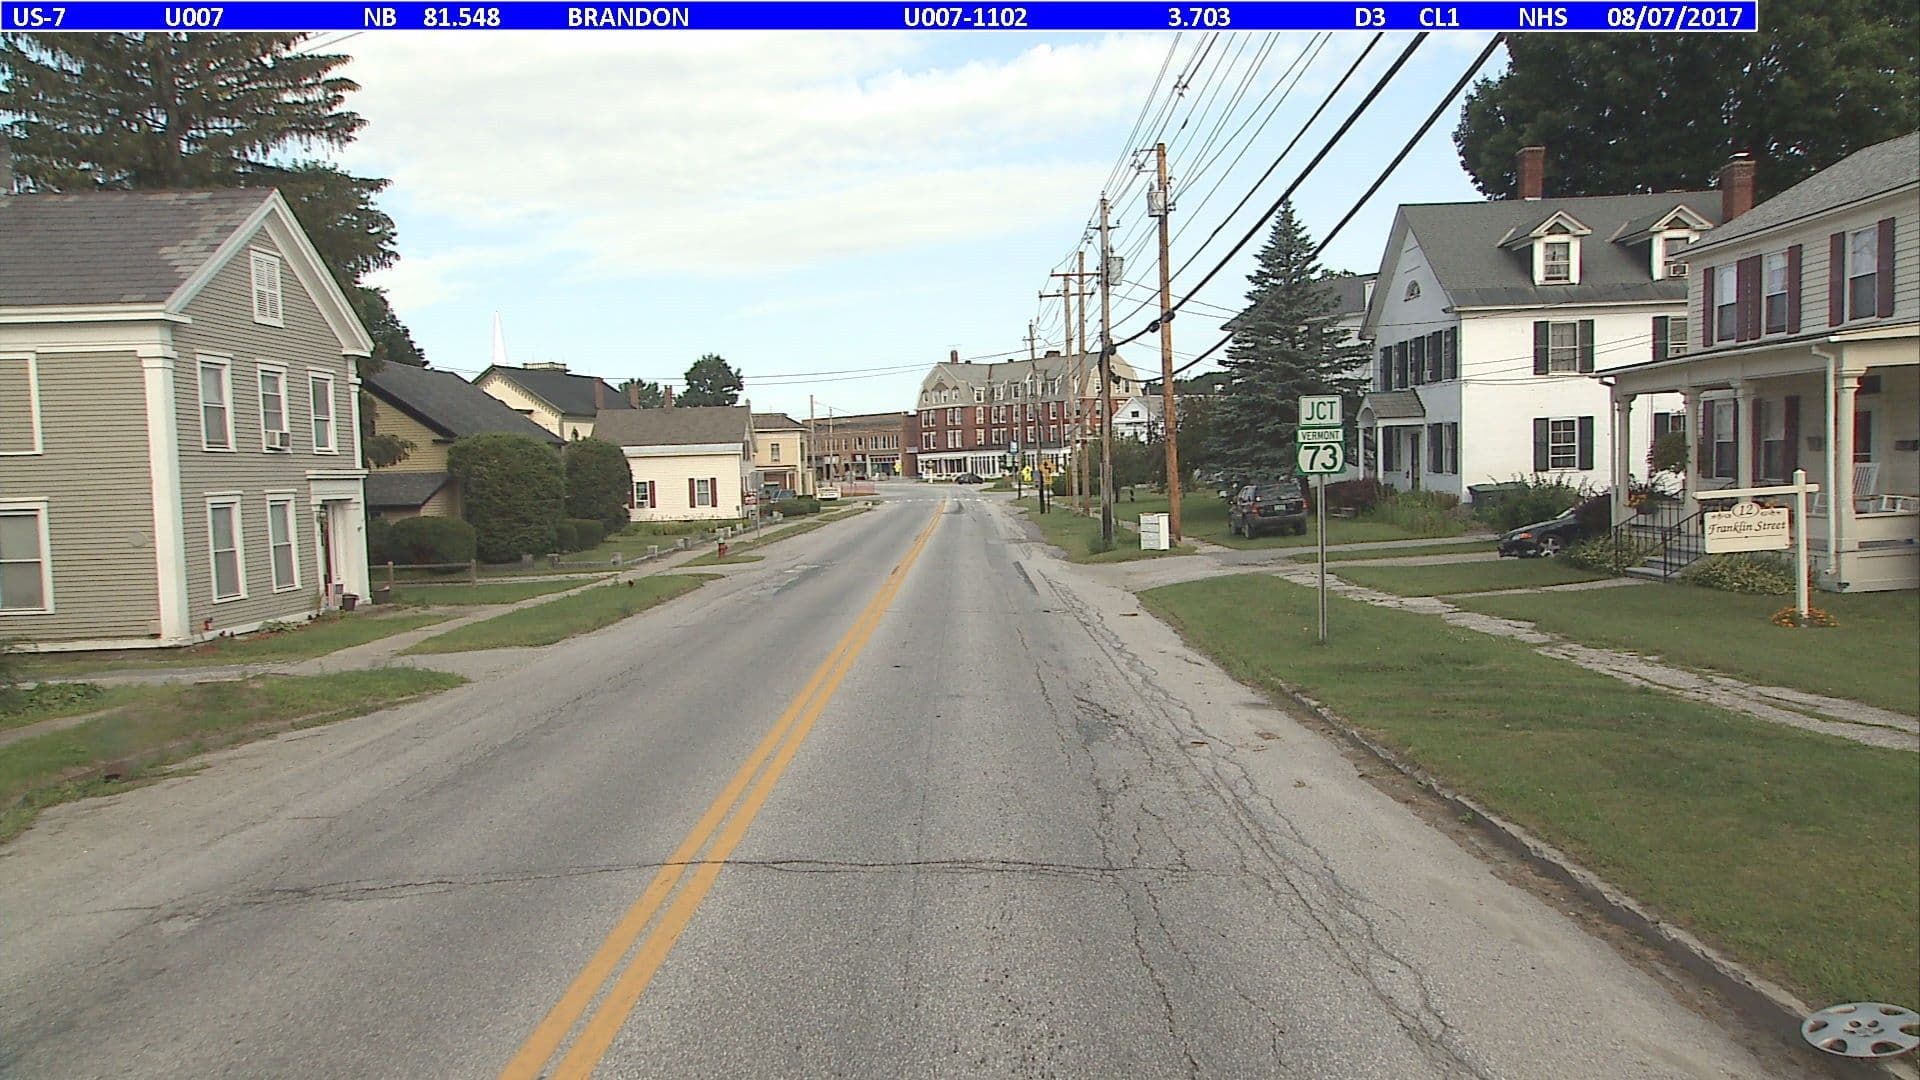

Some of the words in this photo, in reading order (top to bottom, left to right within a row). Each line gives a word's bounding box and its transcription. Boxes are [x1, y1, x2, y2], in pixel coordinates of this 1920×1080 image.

[1305, 401, 1336, 420] JCT
[1301, 431, 1340, 440] VERMONT
[1303, 444, 1337, 471] 73
[1740, 504, 1753, 516] 12
[1708, 521, 1753, 536] Franklin
[1754, 520, 1786, 532] Street
